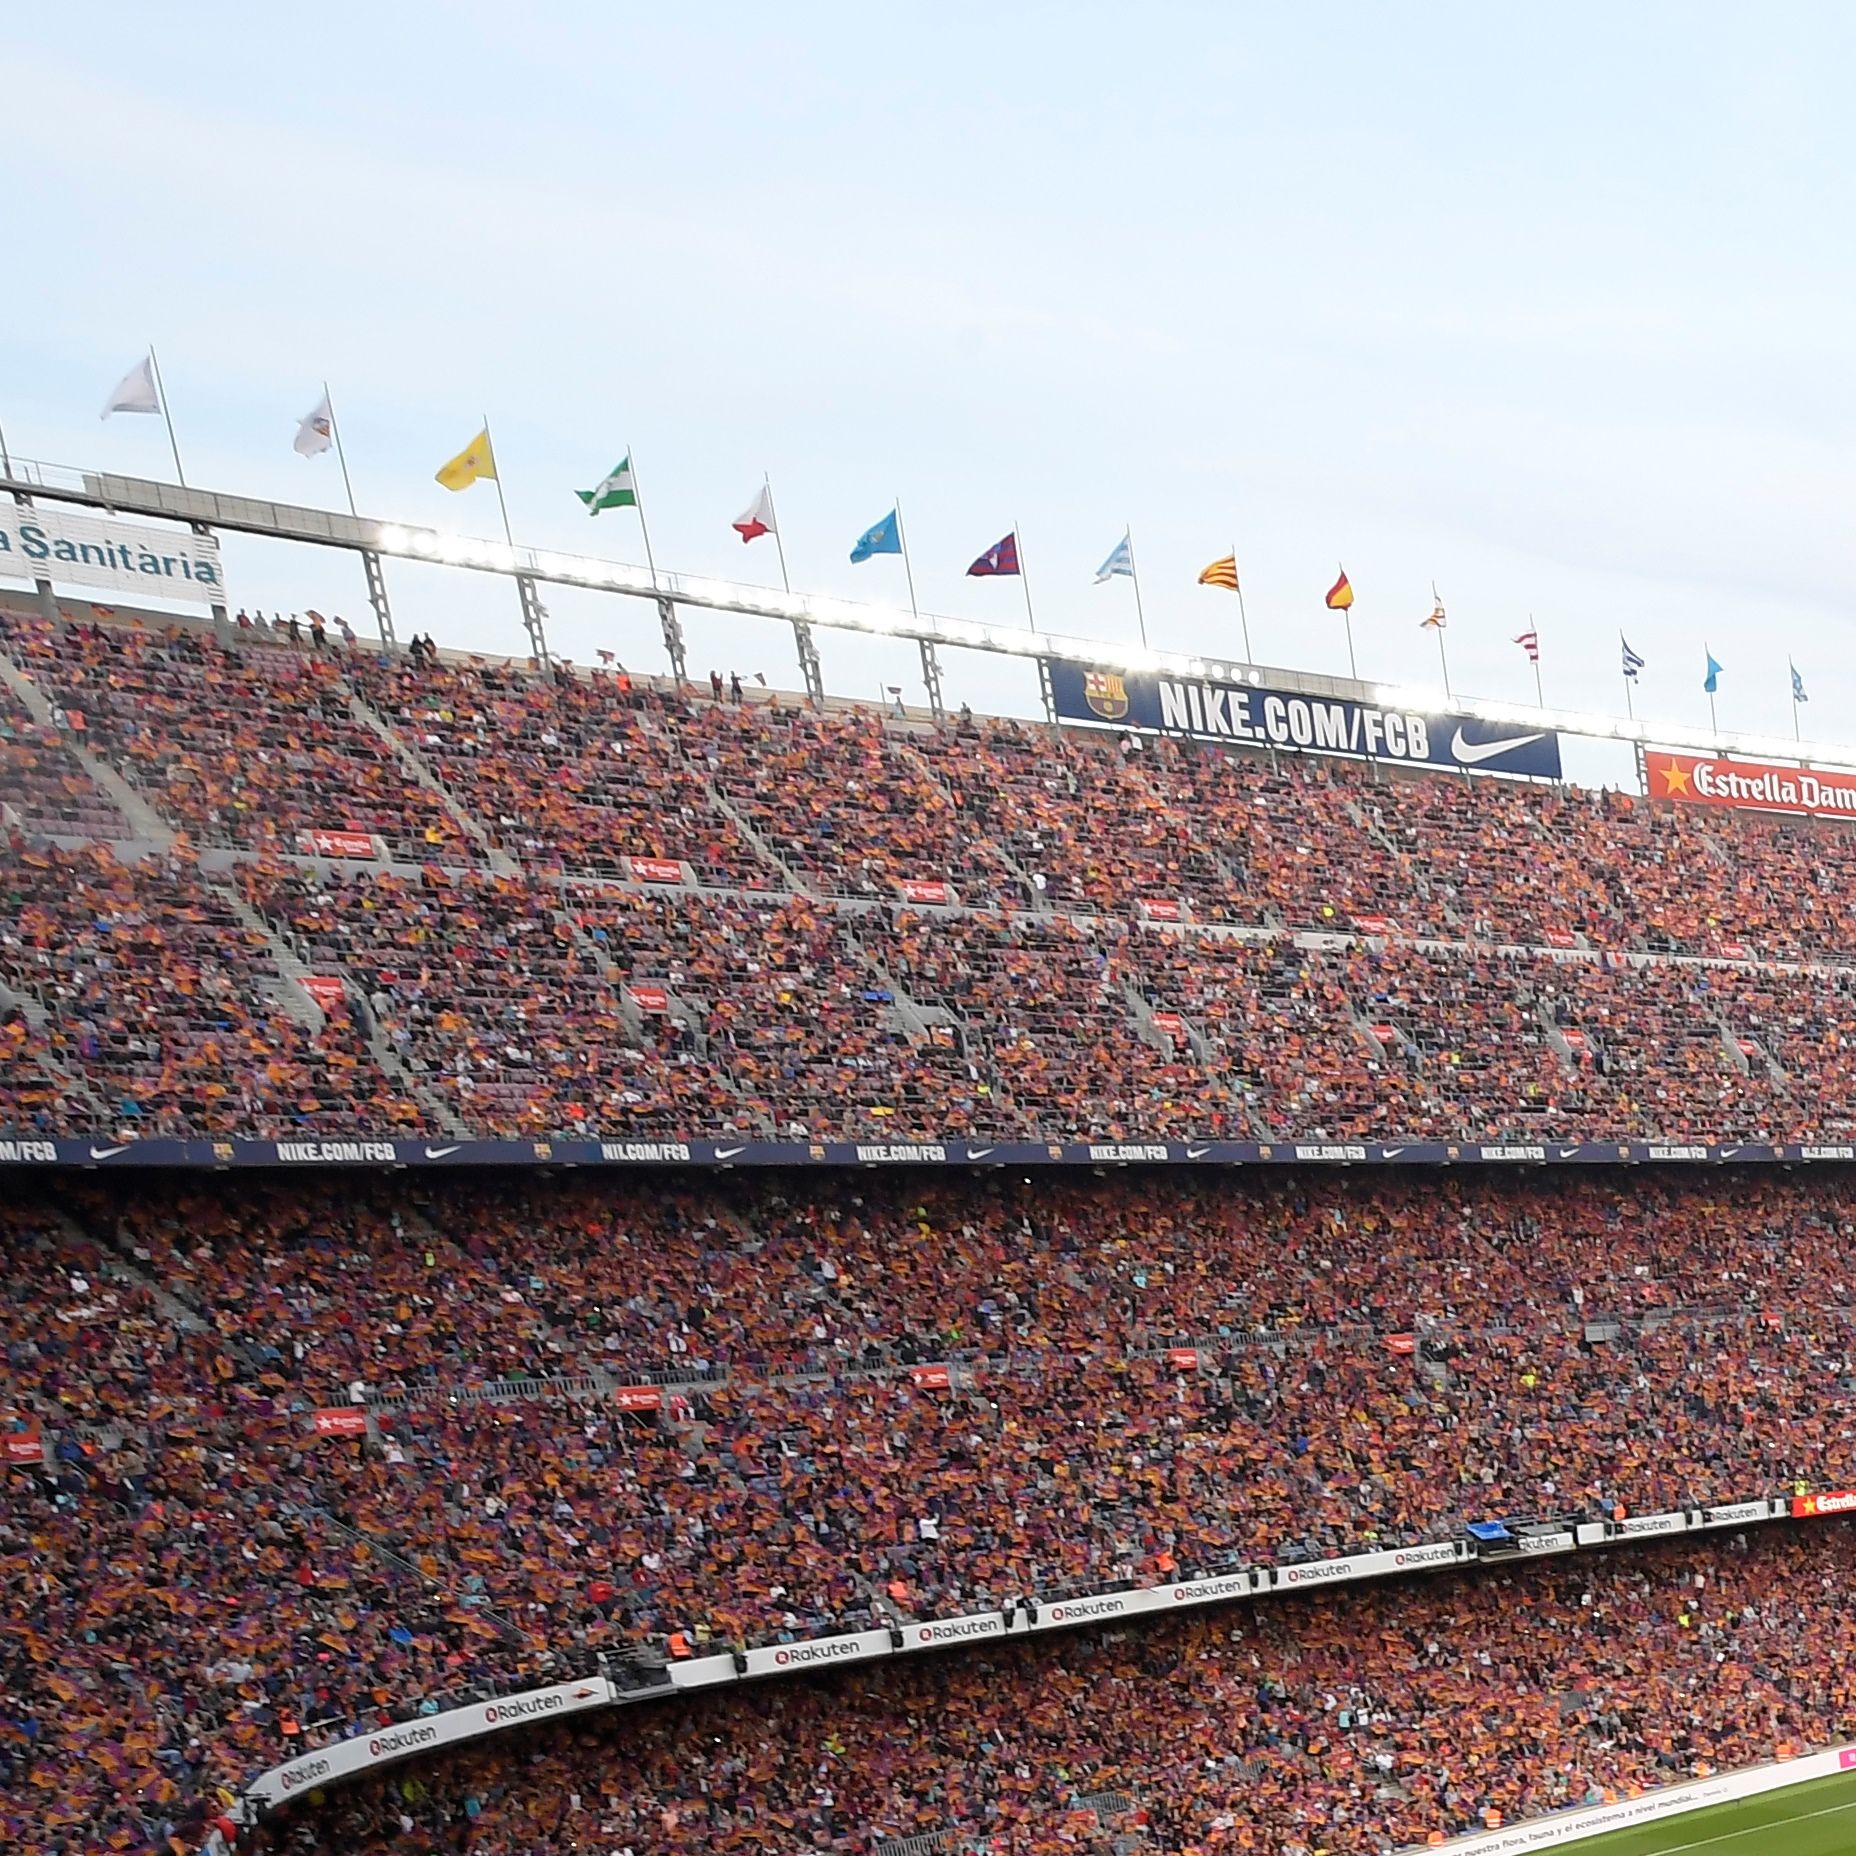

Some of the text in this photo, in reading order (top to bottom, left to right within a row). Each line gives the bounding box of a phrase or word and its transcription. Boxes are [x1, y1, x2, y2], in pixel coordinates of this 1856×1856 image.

[20, 525, 220, 586] Sanitària
[1157, 680, 1431, 760] NIKE.COM/FCB
[1692, 762, 1797, 806] Estrella
[277, 1142, 396, 1162] NIKE.COM/FCB
[857, 1144, 946, 1161] NIKE.COM/FCB
[1405, 1546, 1454, 1564] Rakuten
[1298, 1561, 1352, 1581] Rakuten
[1184, 1579, 1241, 1599] Rakuten
[1064, 1597, 1124, 1618] Rakuten
[932, 1618, 998, 1640] Rakuten
[788, 1638, 860, 1662] Rakuten
[499, 1692, 564, 1721] Rakuten
[379, 1724, 437, 1752] Rakuten
[1528, 1828, 1555, 1845] fauna
[1575, 1810, 1626, 1830] ecosistema
